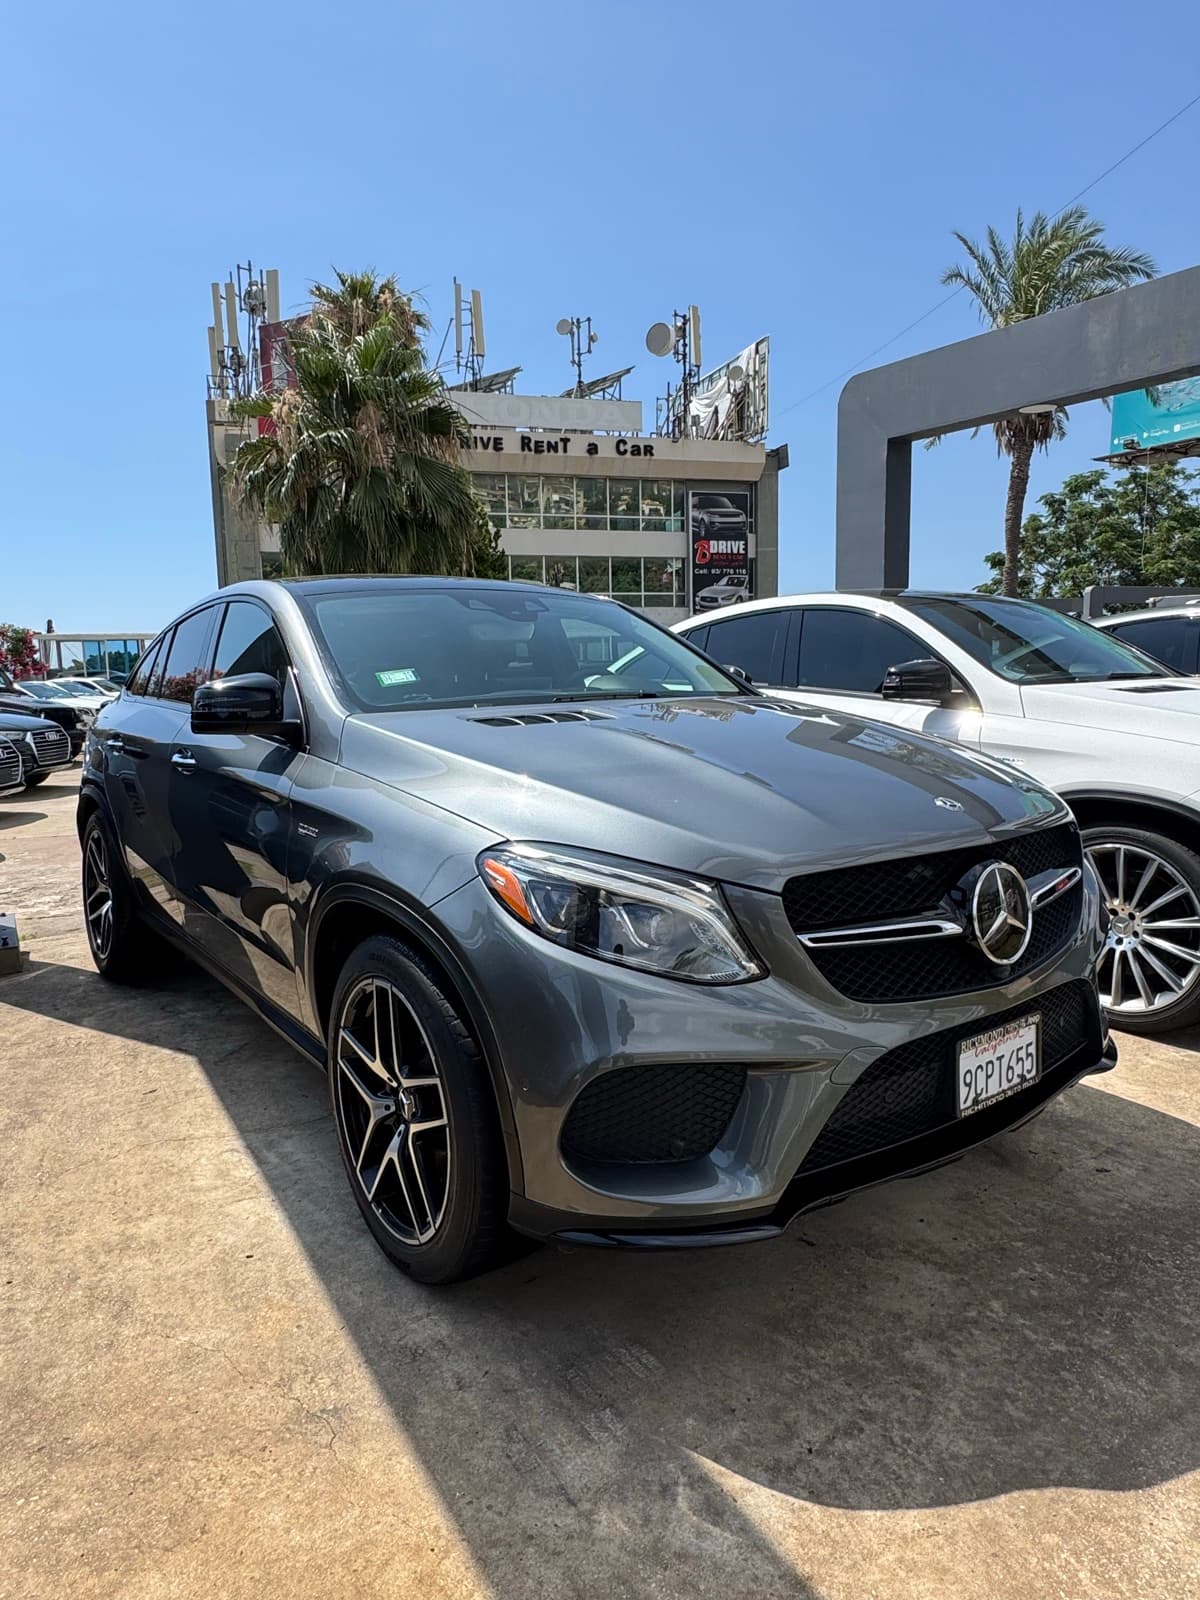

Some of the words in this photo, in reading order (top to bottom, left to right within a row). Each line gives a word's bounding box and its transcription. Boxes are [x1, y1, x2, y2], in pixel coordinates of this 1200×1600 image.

[459, 433, 504, 452] RIVE
[710, 540, 746, 554] DRIVE
[963, 1041, 1034, 1105] 9CPT655
